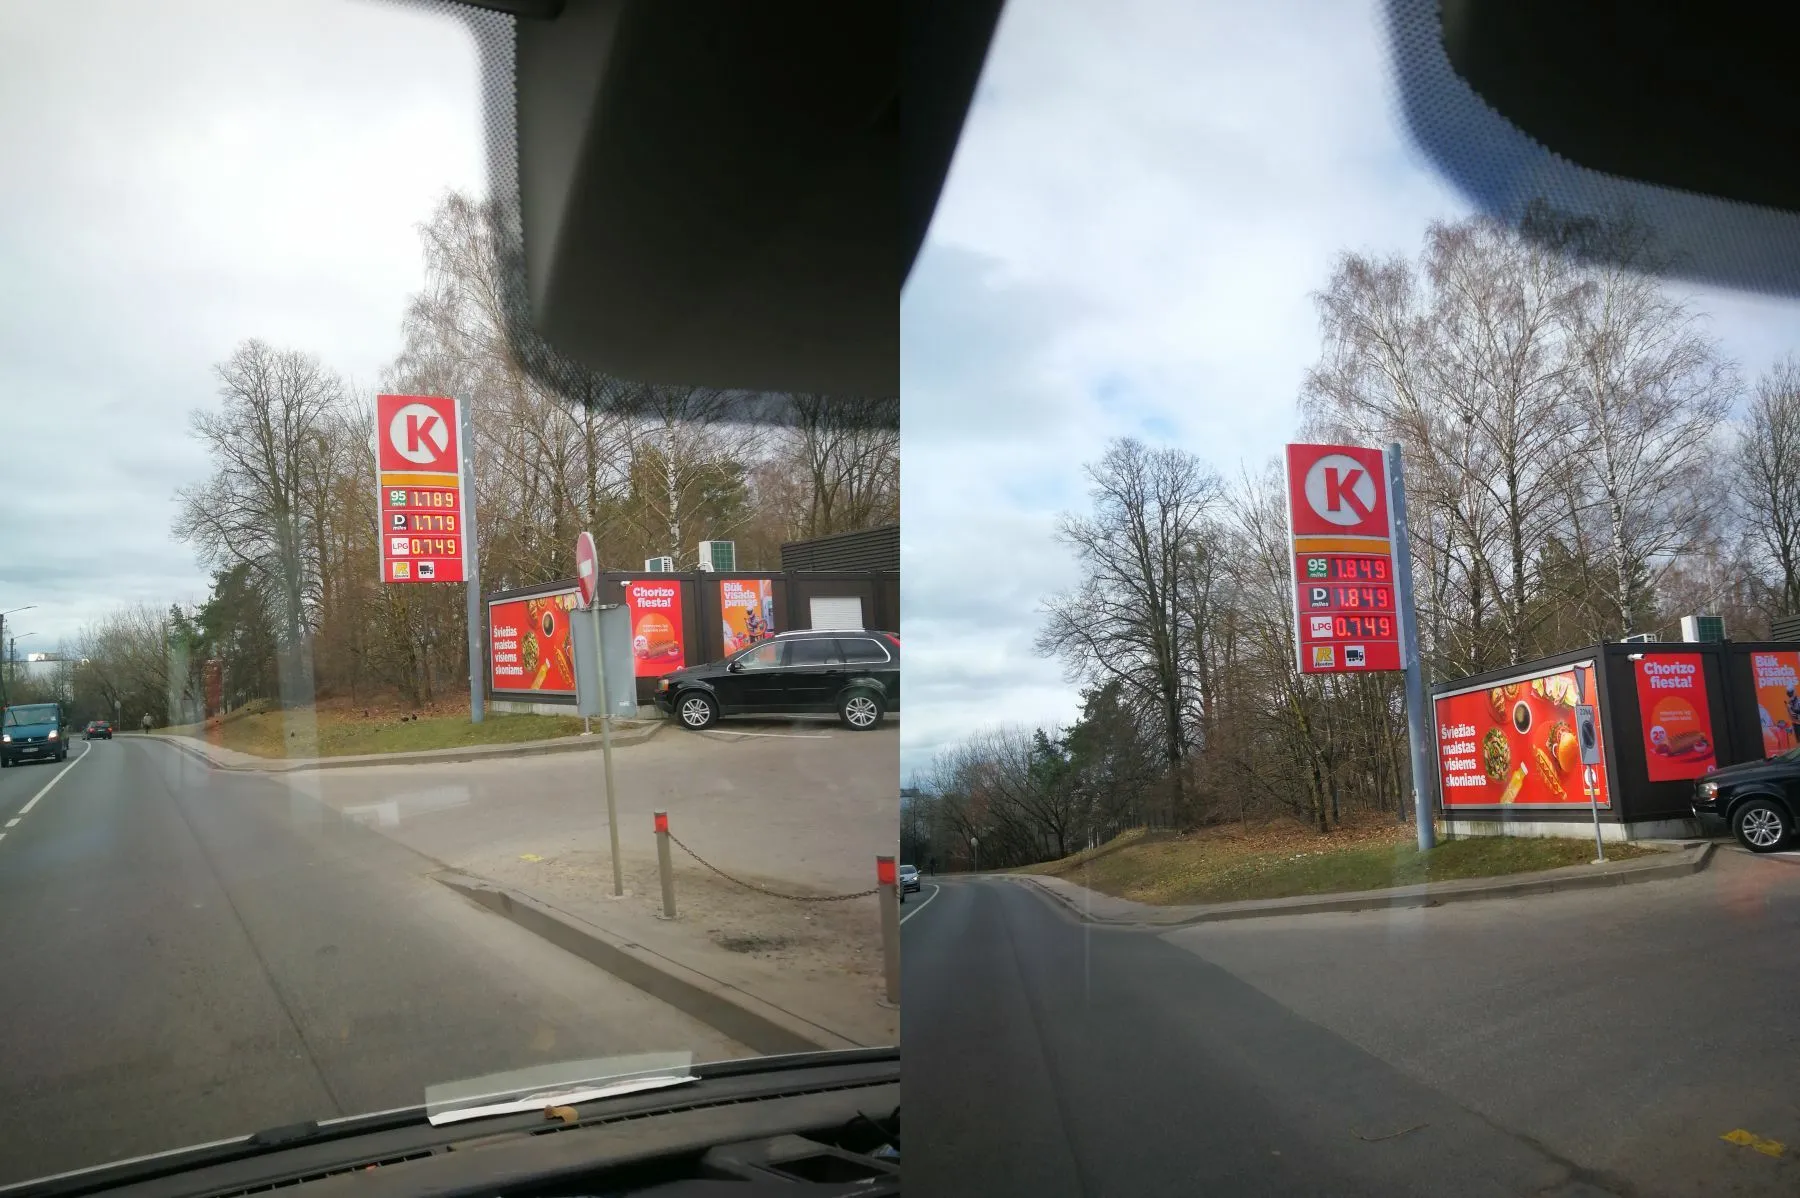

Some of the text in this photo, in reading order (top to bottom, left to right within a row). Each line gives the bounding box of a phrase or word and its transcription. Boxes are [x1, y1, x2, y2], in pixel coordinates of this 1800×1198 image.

[407, 415, 444, 460] K
[391, 491, 454, 507] 95 1.789
[1324, 467, 1373, 521] K
[394, 515, 455, 530] D 1.779
[412, 539, 455, 554] 0.749
[1308, 559, 1385, 578] 95 1.849
[633, 587, 675, 597] Chorizo
[1313, 588, 1387, 607] D 1.849
[637, 598, 671, 608] fiesta!
[1313, 617, 1390, 636] LPG 0.749
[495, 639, 516, 650] maistas
[495, 652, 517, 662] visiems
[495, 664, 523, 675] skoniams
[1644, 662, 1695, 674] Chorizo
[1756, 664, 1795, 677] visada
[1650, 676, 1692, 688] fiesta!
[1441, 724, 1475, 739] Šviežias
[1443, 741, 1475, 755] maistas
[1444, 757, 1476, 771] visiems
[1446, 773, 1486, 787] skoniams
